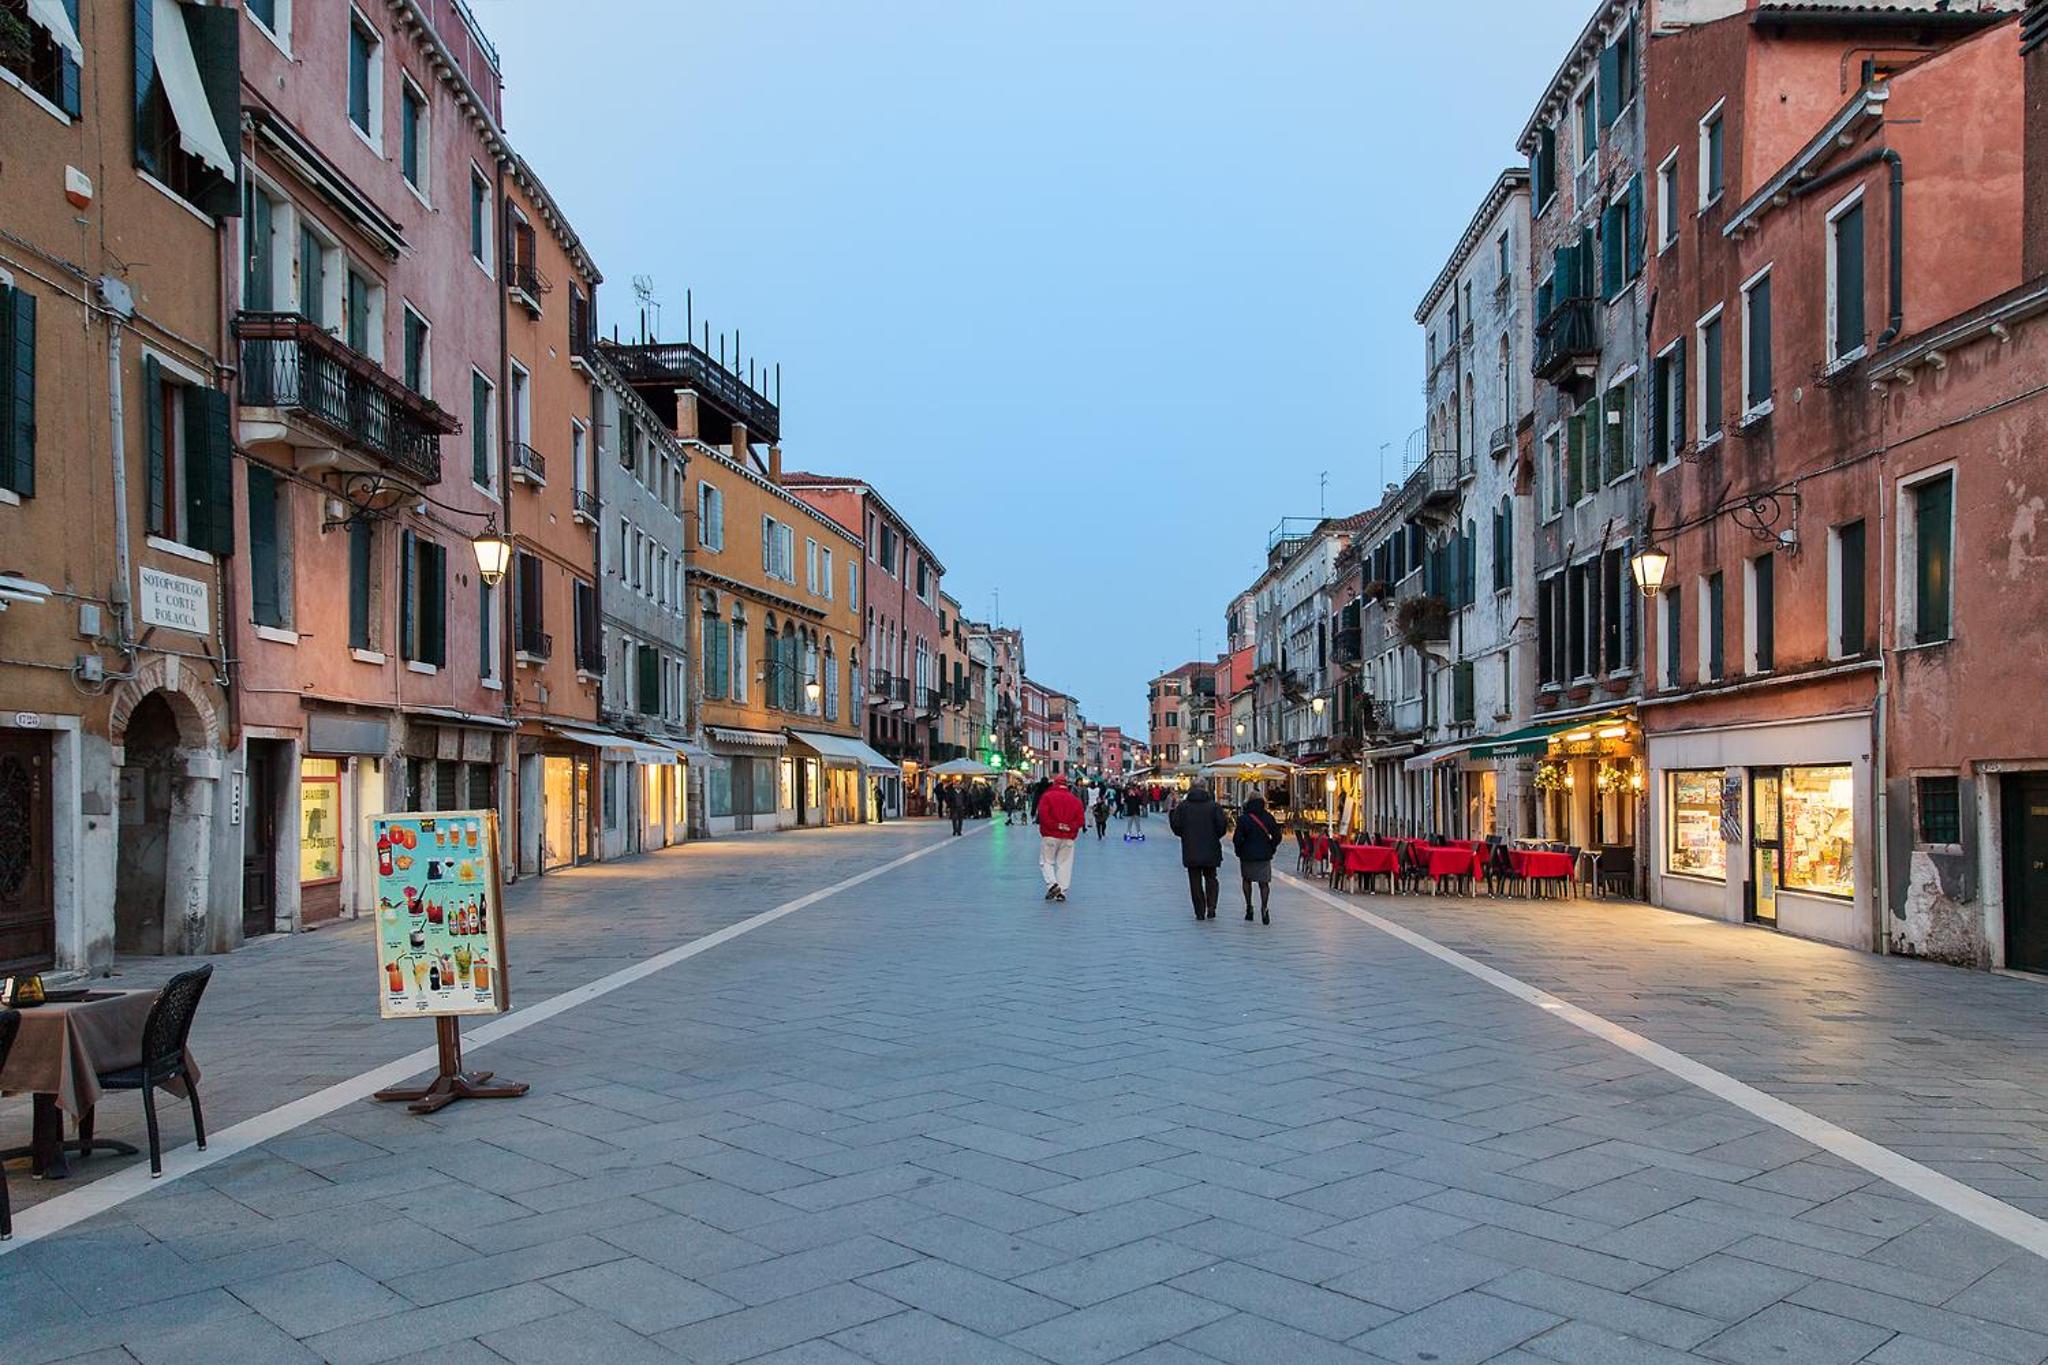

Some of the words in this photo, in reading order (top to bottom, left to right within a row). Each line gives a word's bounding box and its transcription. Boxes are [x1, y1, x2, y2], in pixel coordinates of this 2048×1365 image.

[143, 571, 203, 598] SOTOPORTEGO
[155, 592, 161, 603] E
[166, 596, 197, 611] CORTE
[155, 608, 197, 627] POLACCA
